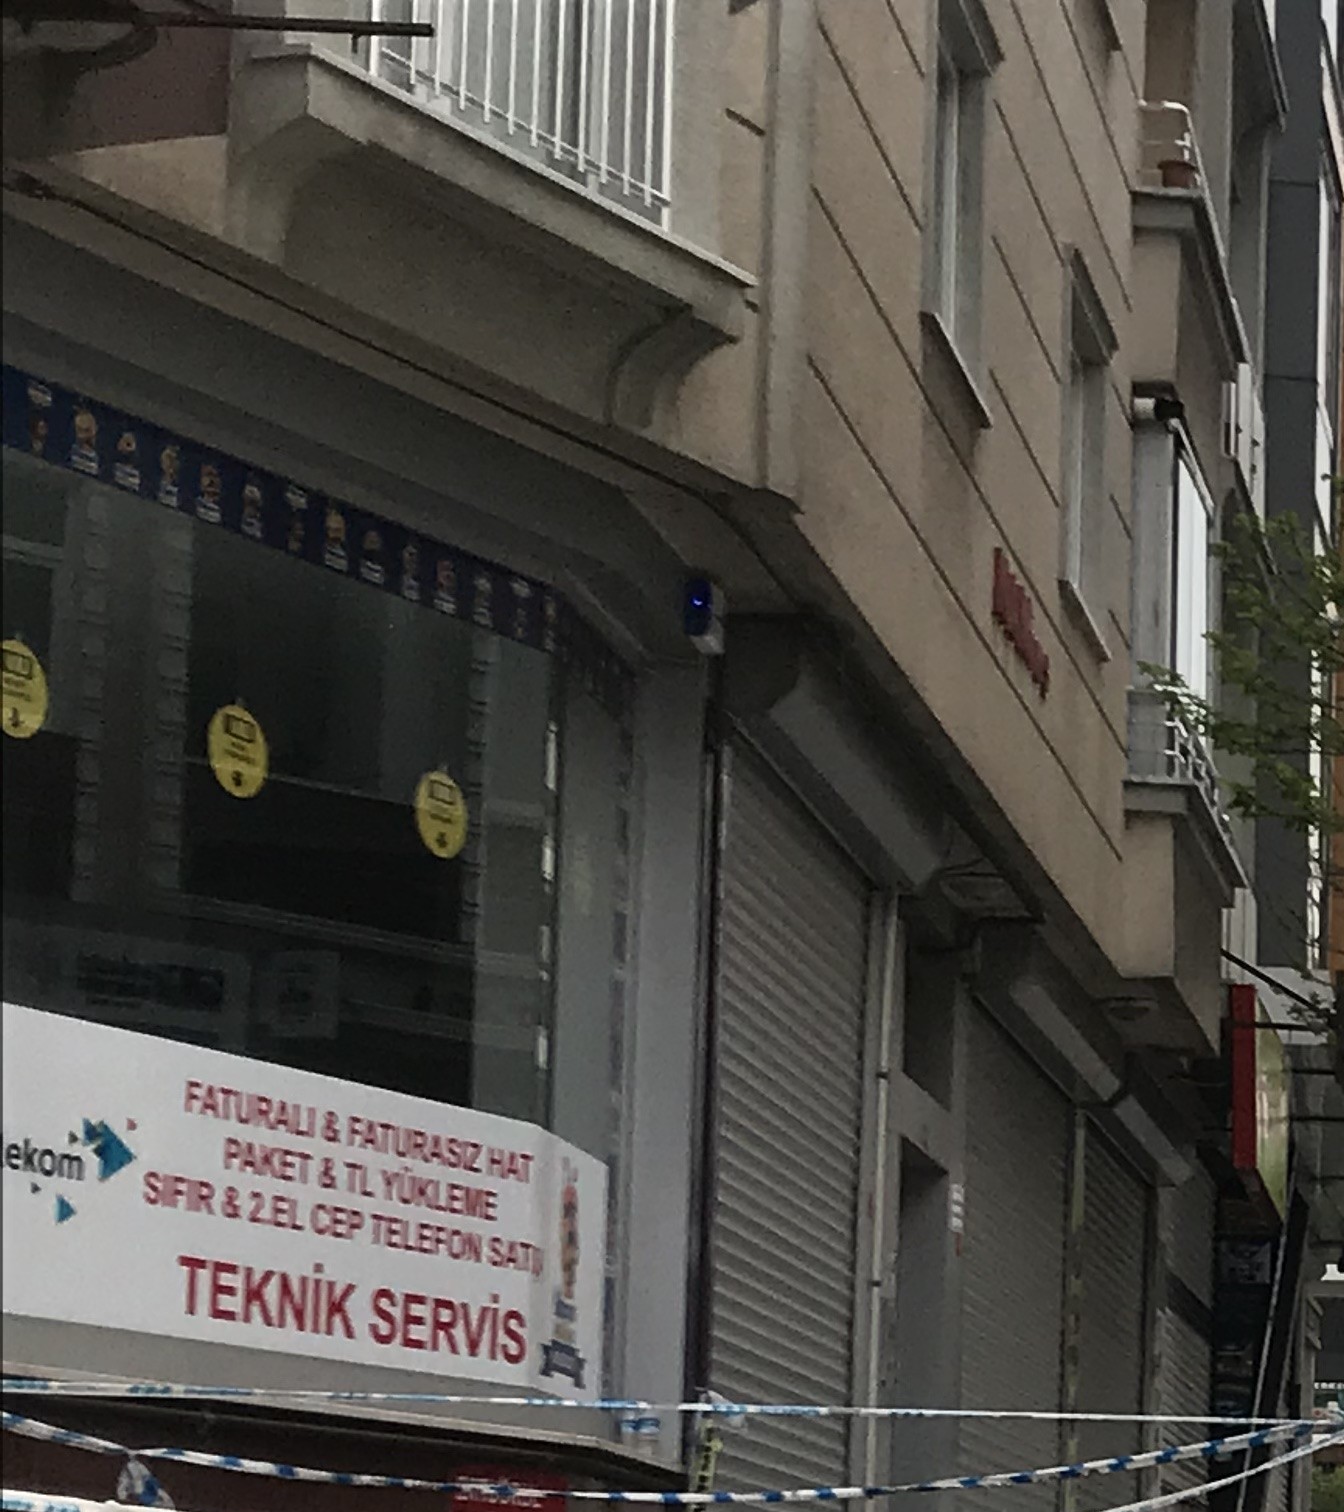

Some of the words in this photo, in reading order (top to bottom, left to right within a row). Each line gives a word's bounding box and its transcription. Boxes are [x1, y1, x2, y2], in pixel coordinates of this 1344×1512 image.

[2, 1137, 86, 1182] ekom
[184, 1080, 317, 1138] FATURALI
[322, 1111, 341, 1143] &
[346, 1115, 483, 1174] FATURASIZ
[486, 1147, 535, 1184] HAT
[143, 1171, 216, 1216] SIFIR
[221, 1186, 243, 1219] &
[310, 1203, 365, 1241] CEP
[370, 1213, 483, 1264] TELEFON
[223, 1136, 314, 1185] PAKET
[318, 1157, 339, 1190] &
[344, 1161, 376, 1198] TL
[380, 1166, 498, 1222] YÜKLEME
[176, 1253, 358, 1341] TEKNİK
[367, 1287, 528, 1366] SERVİS
